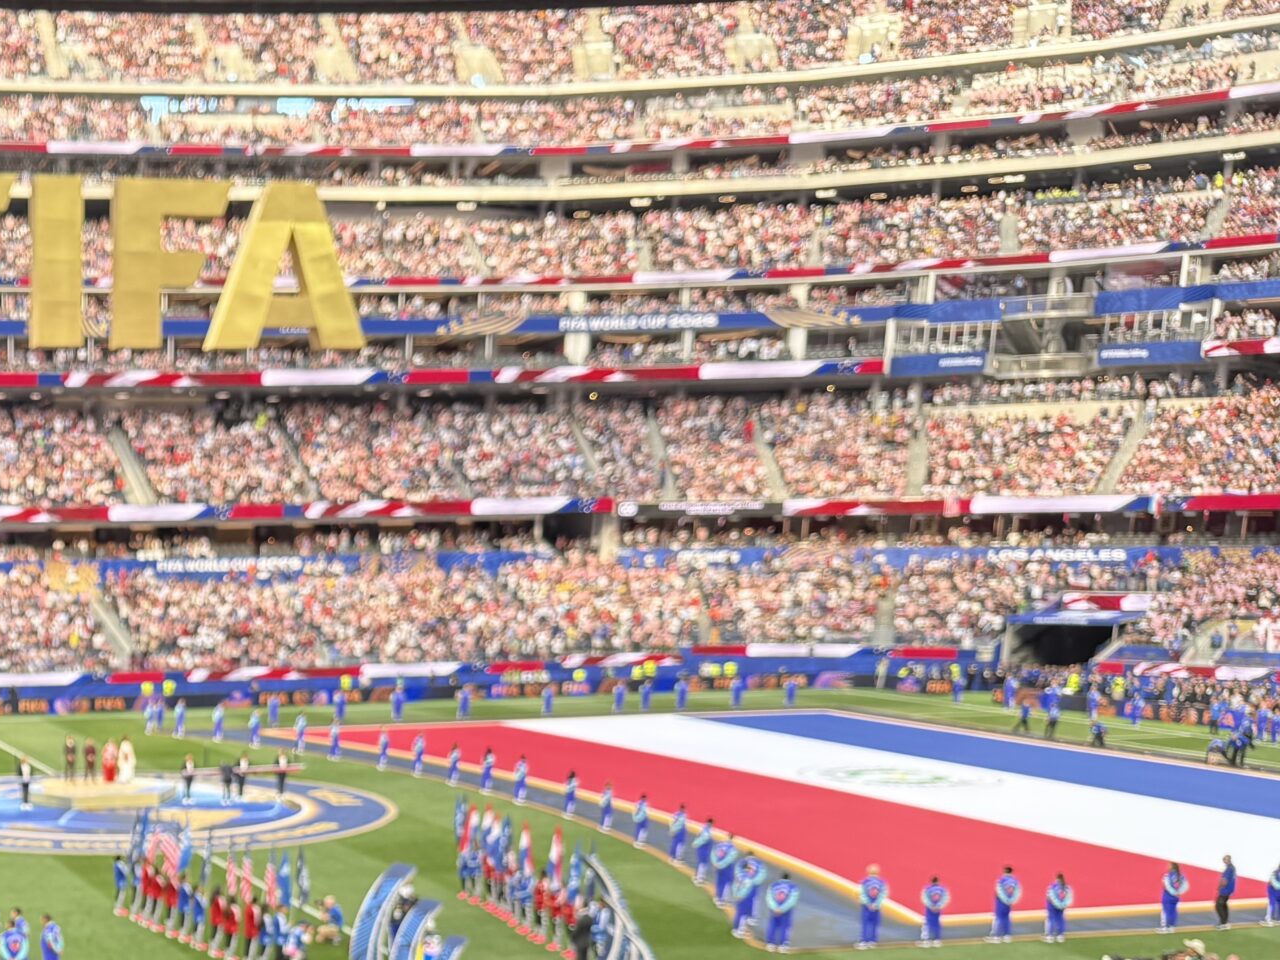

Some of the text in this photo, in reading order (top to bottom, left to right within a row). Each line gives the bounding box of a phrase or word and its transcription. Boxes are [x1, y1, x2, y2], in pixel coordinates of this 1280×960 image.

[559, 316, 588, 332] FIFA
[589, 316, 639, 331] WORLD
[639, 315, 667, 329] CUP
[1030, 549, 1127, 562] ANGELES
[156, 558, 183, 572] FIFA
[184, 558, 231, 572] WORLD
